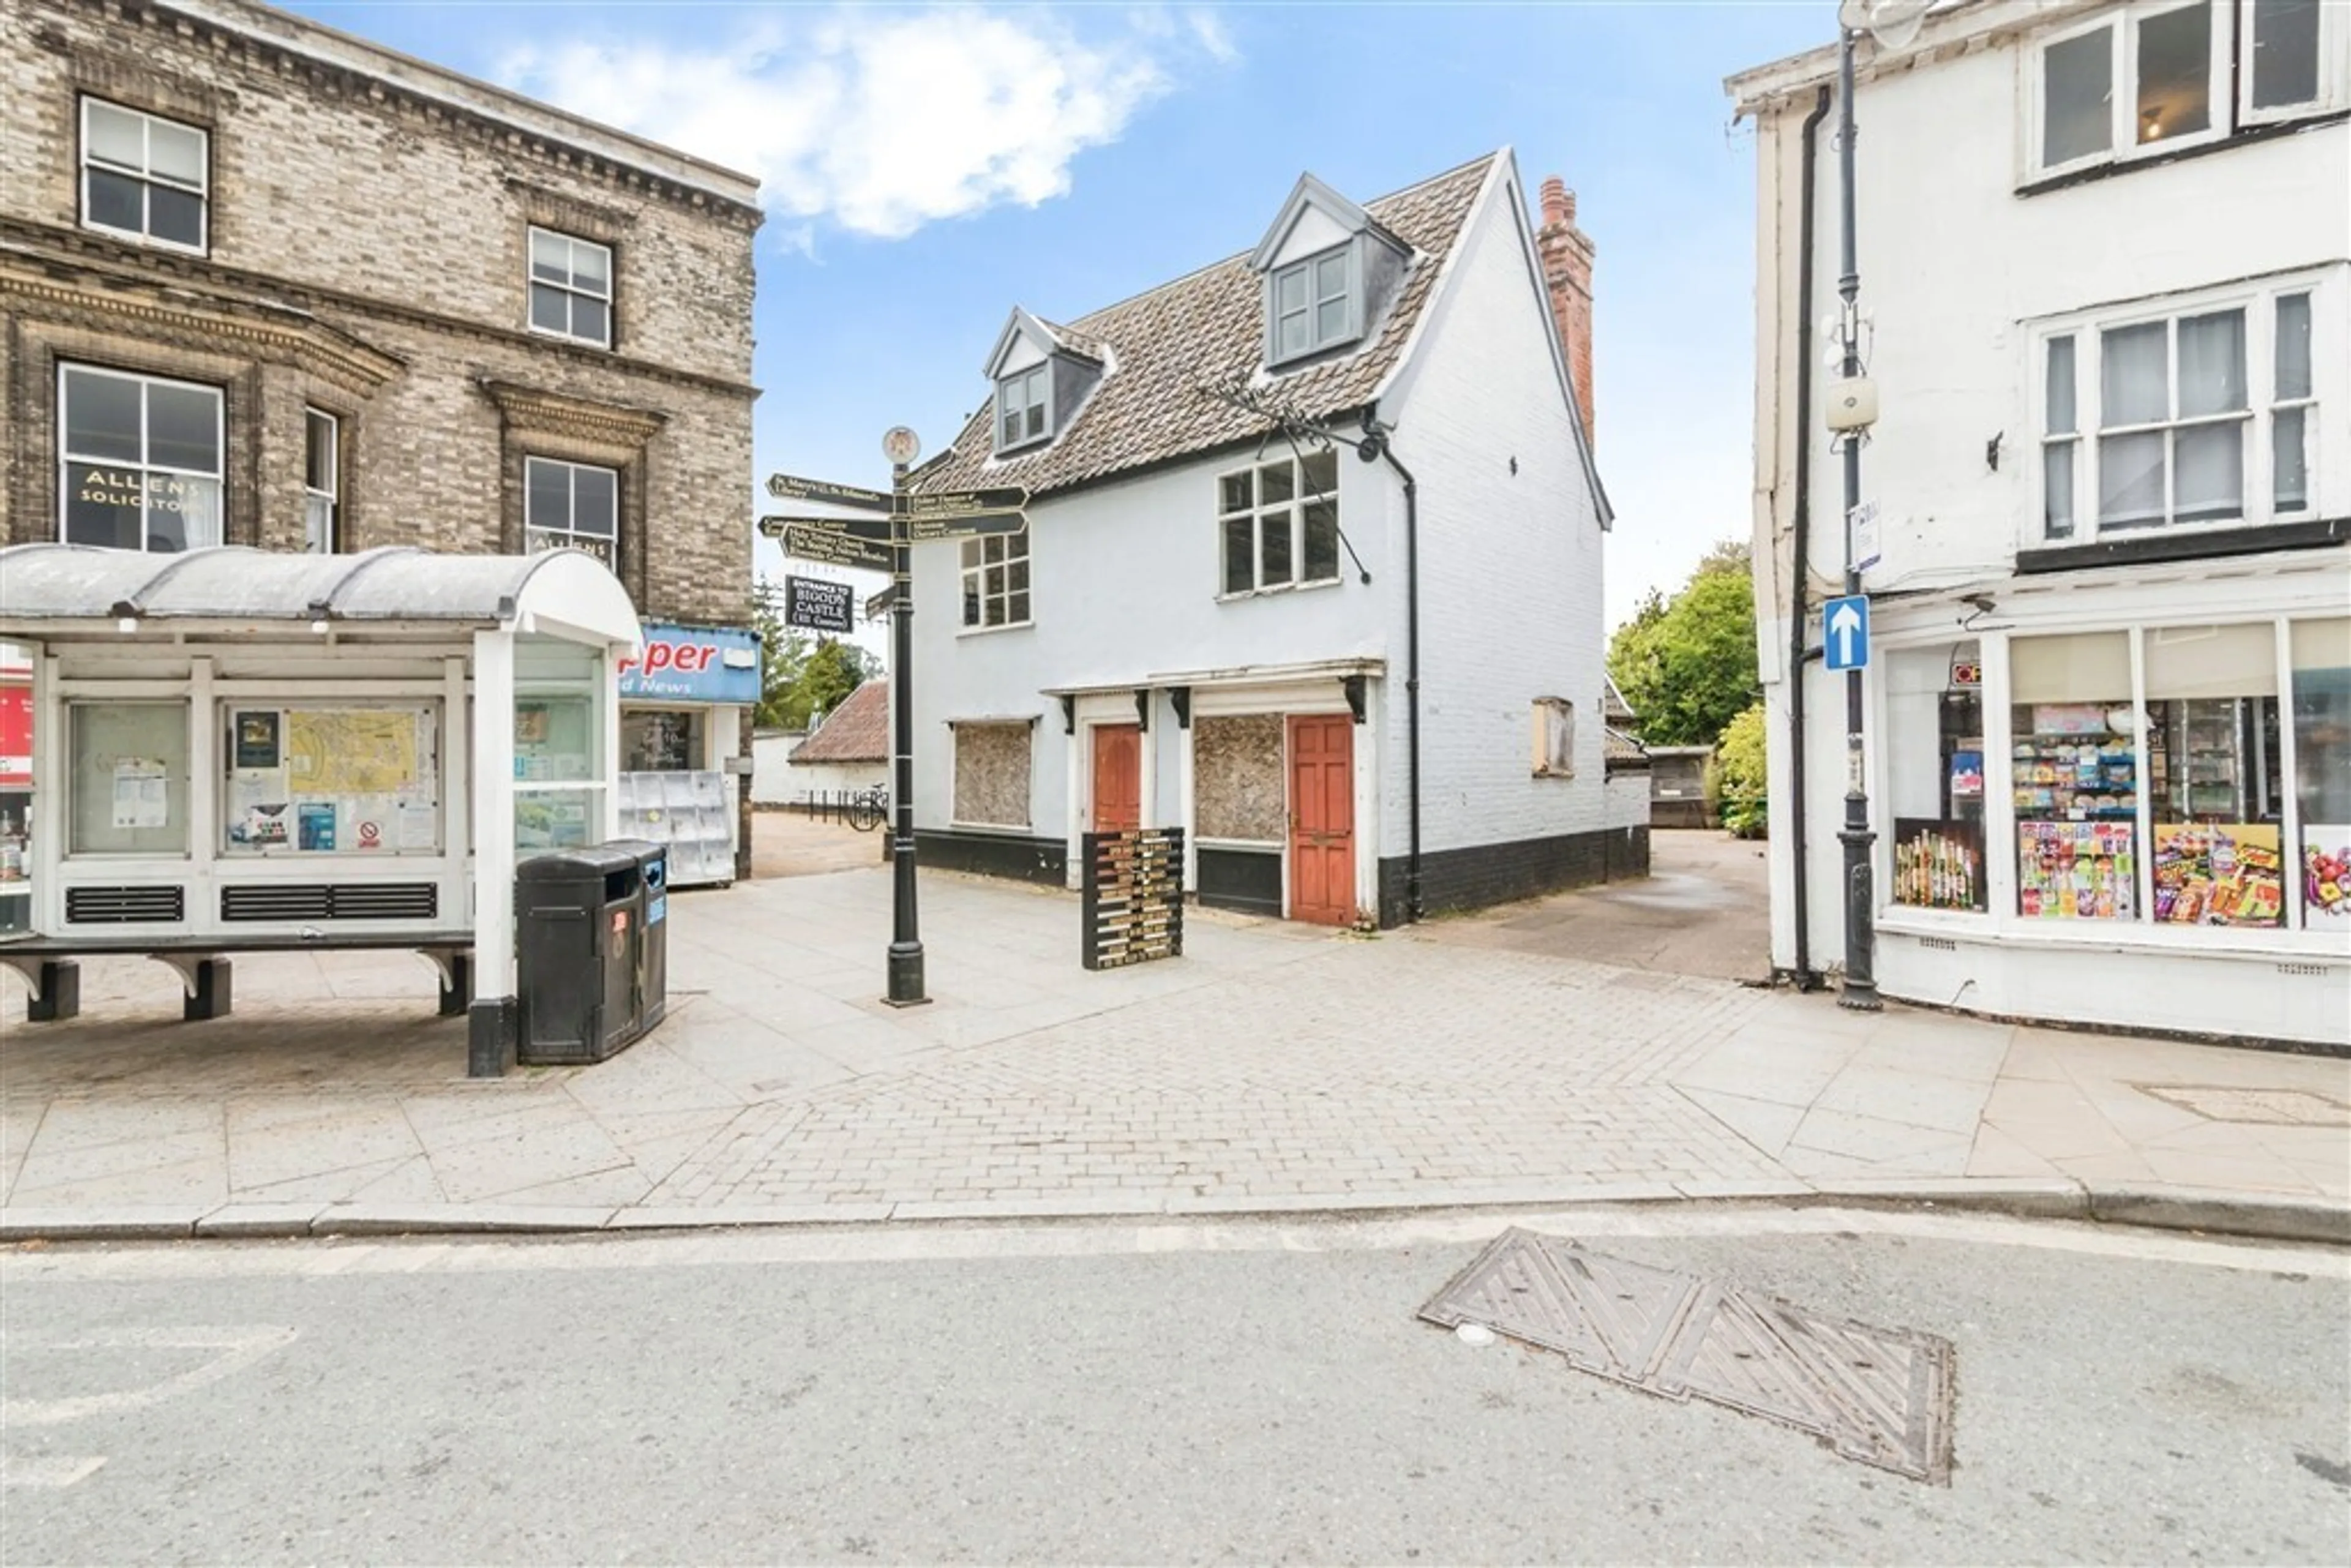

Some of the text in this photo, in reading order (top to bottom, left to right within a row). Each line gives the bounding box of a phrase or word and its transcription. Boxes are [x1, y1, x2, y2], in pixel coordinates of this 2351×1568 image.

[86, 470, 199, 497] ALLENS
[80, 489, 203, 514] SOLICITO
[792, 579, 849, 595] ENTRANCE TO
[797, 601, 846, 617] CASTLE
[640, 680, 693, 694] News
